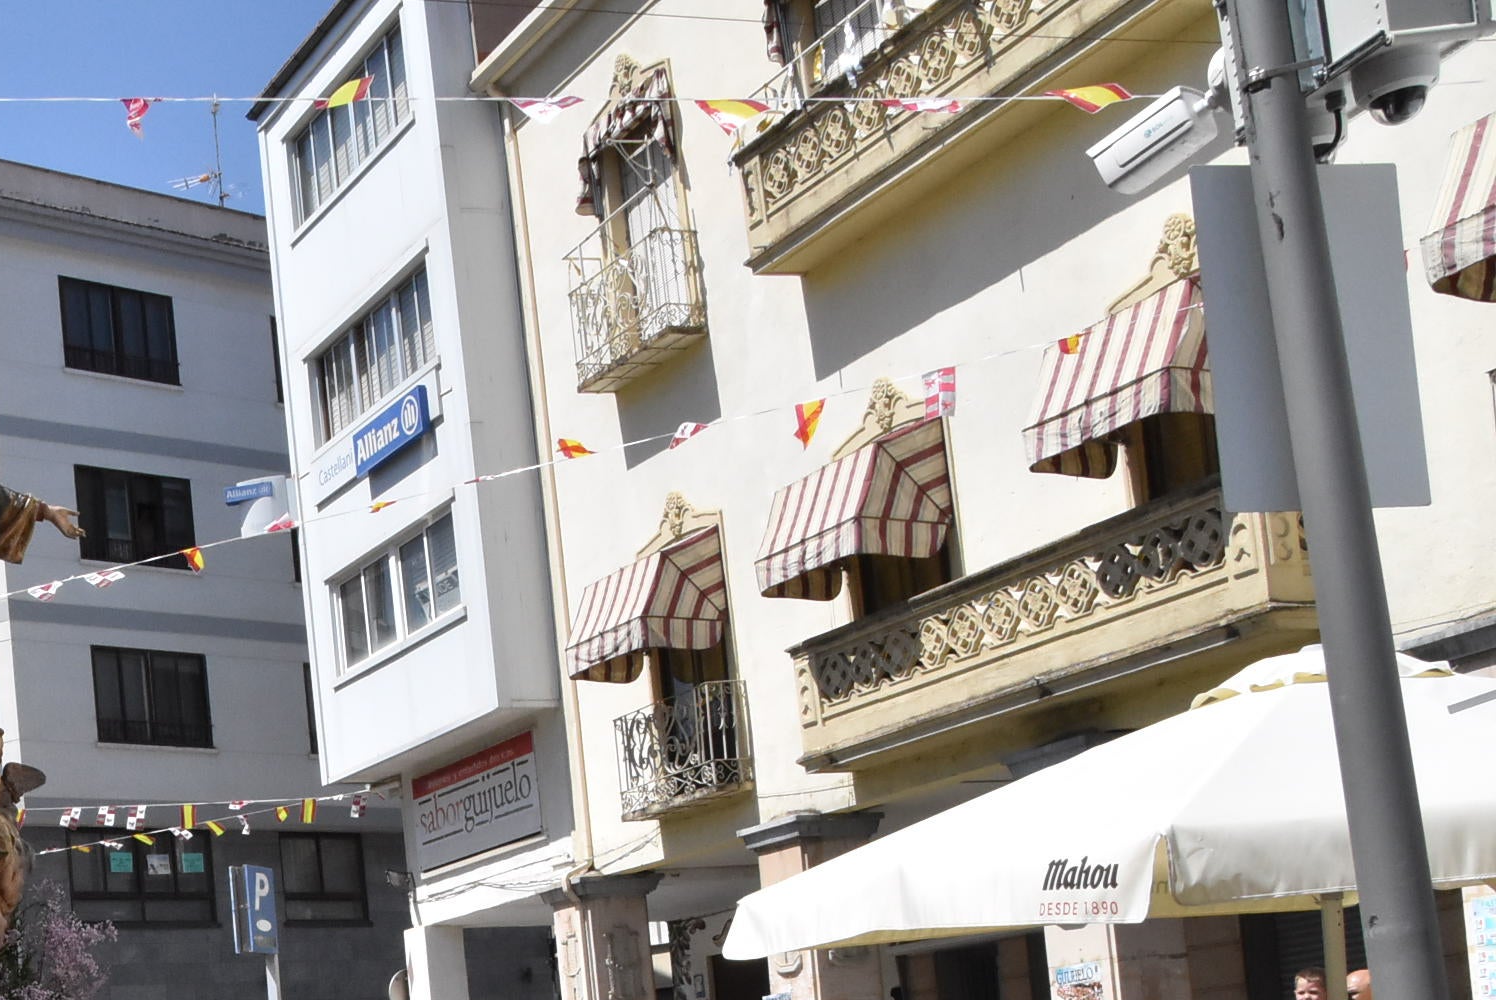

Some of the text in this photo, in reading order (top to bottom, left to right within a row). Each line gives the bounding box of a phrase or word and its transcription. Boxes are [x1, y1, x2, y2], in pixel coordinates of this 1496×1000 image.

[356, 417, 400, 466] Allianz
[318, 448, 354, 487] Castellani
[226, 486, 258, 499] Allianz
[1042, 856, 1120, 890] Mahou
[255, 872, 270, 911] P
[1039, 901, 1119, 916] DESDE 1890
